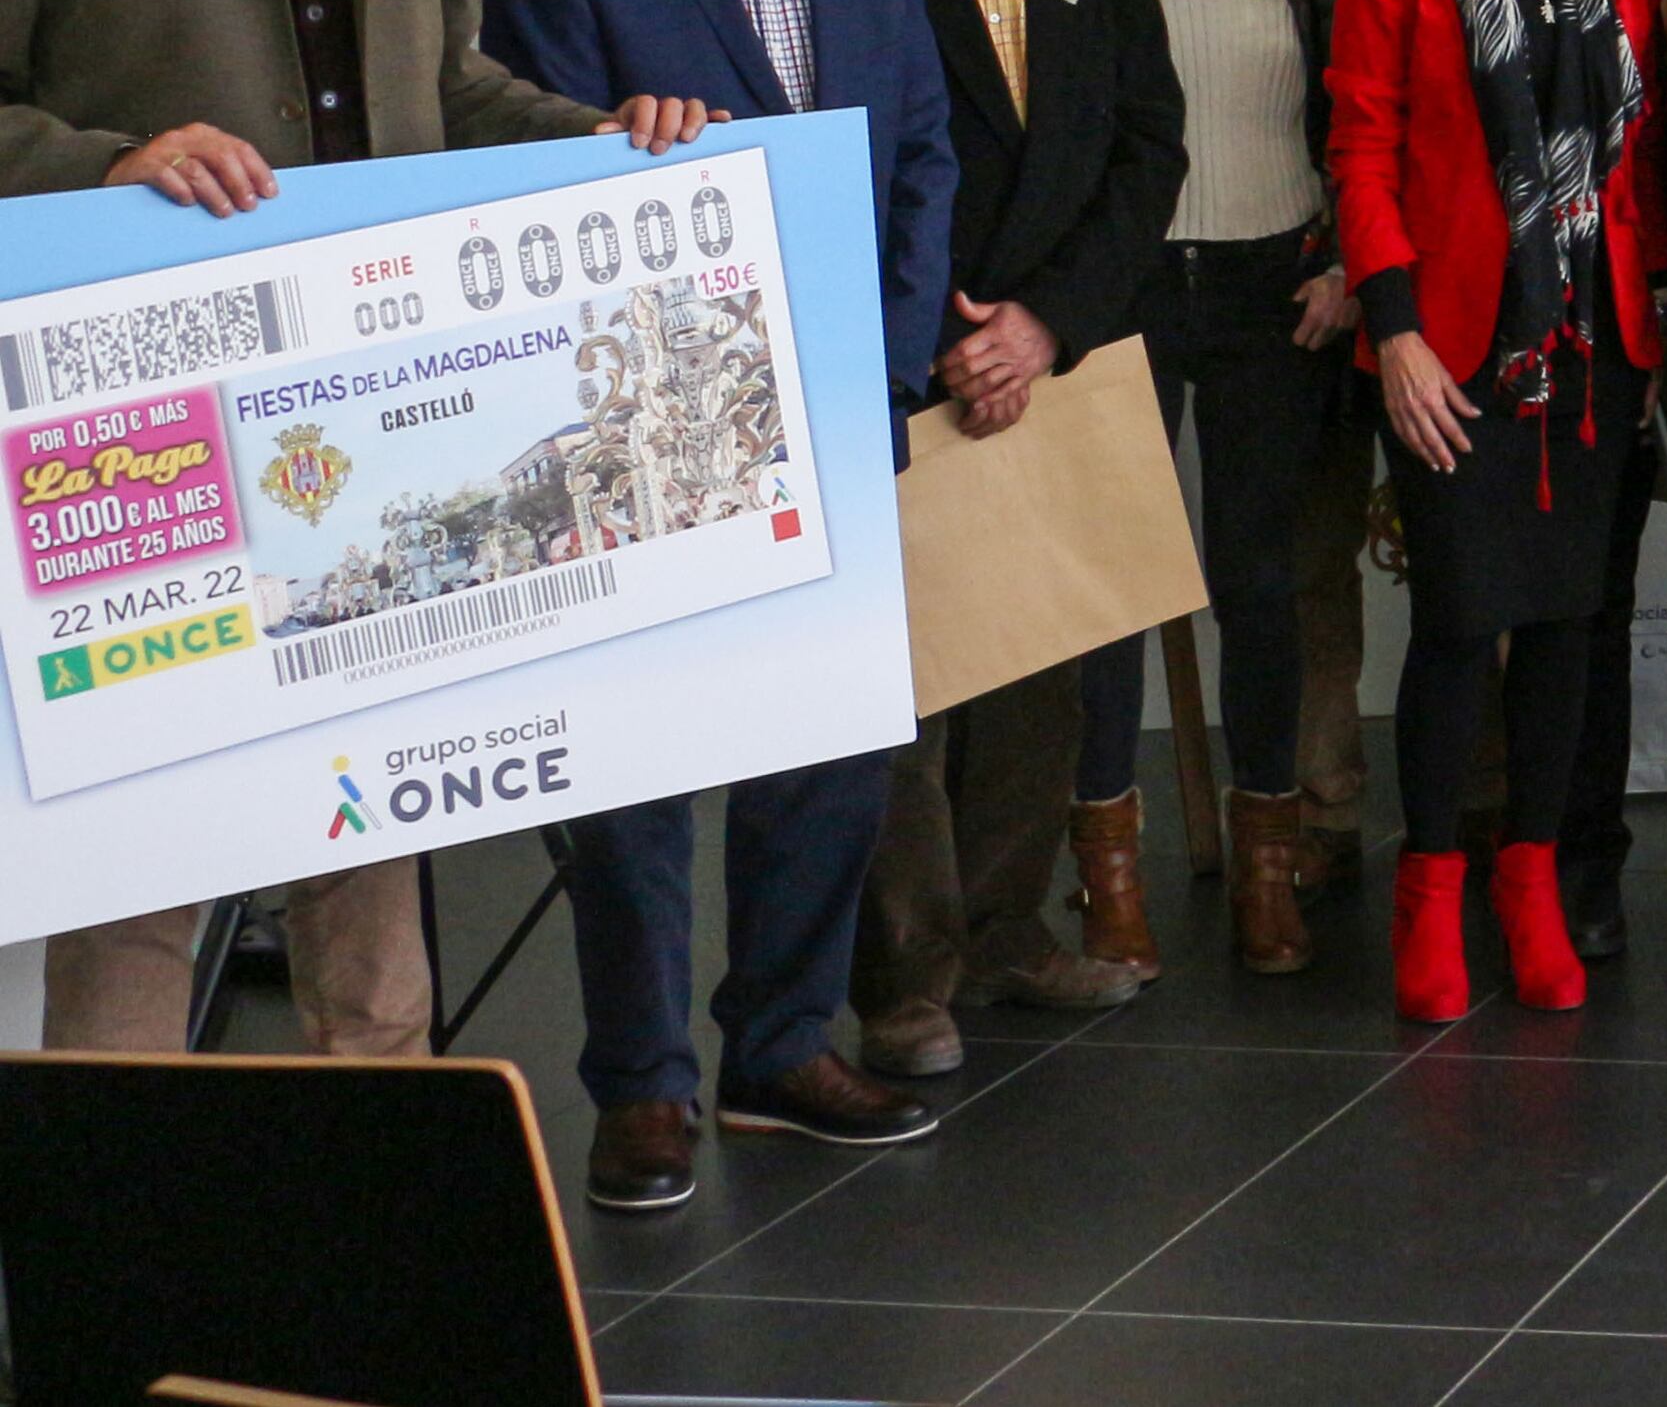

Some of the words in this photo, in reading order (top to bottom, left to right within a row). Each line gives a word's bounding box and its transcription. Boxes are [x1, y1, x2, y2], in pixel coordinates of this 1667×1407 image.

[352, 255, 414, 287] SERIE
[699, 265, 740, 297] 1,50
[743, 262, 758, 287] €
[354, 292, 424, 336] 000
[237, 375, 347, 422] FIESTAS
[352, 372, 380, 397] DE
[385, 366, 410, 389] LA
[413, 325, 572, 382] MAGDALENA
[29, 428, 66, 454] POR
[73, 411, 126, 447] 0,50
[130, 410, 142, 432] €
[149, 398, 188, 429] MÁS
[381, 388, 475, 432] CASTELLÓ
[20, 459, 95, 507] La
[93, 439, 212, 488] Paga
[28, 495, 125, 551] 3.000
[127, 503, 142, 528] €
[147, 498, 173, 523] AL
[177, 484, 221, 517] MES
[36, 537, 134, 586] DURANTE
[138, 526, 166, 560] 25
[172, 516, 226, 550] AÑOS
[50, 604, 93, 638] 22
[104, 581, 196, 625] MAR.
[203, 565, 244, 599] 22
[103, 612, 243, 674] ONCE
[385, 735, 476, 776] grupo
[485, 710, 568, 749] social
[389, 747, 571, 823] ONCE
